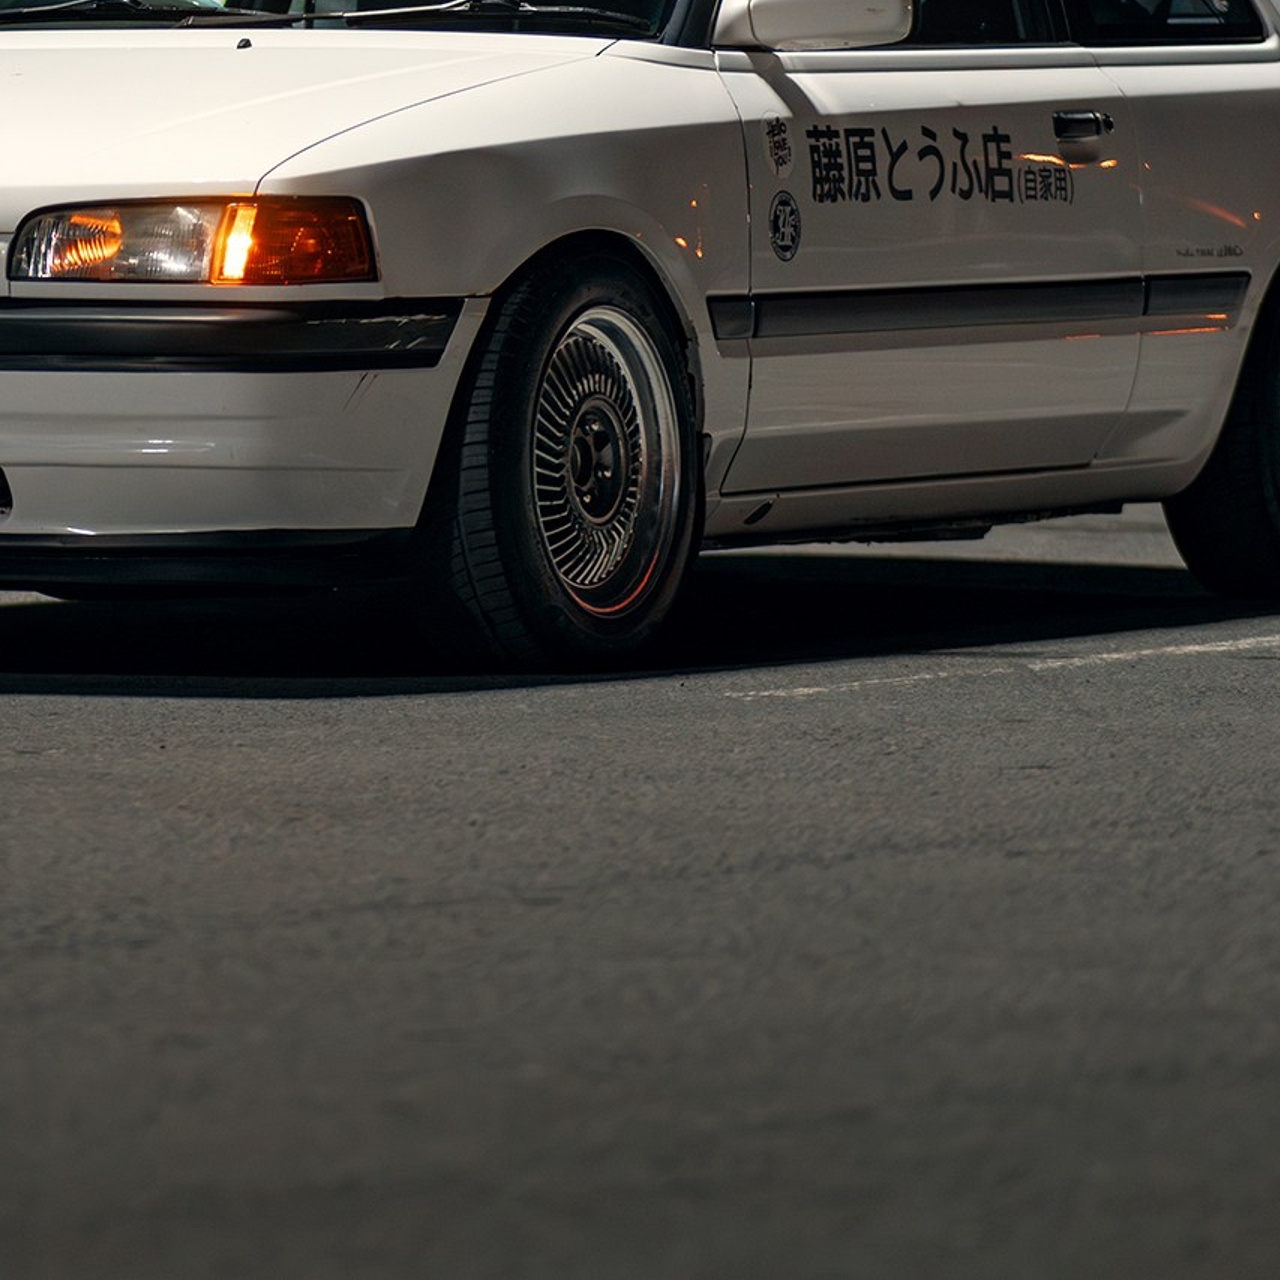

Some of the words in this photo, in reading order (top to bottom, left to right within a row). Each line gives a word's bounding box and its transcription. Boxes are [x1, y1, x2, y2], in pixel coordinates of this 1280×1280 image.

[807, 125, 1015, 203] 藤原とうふ店
